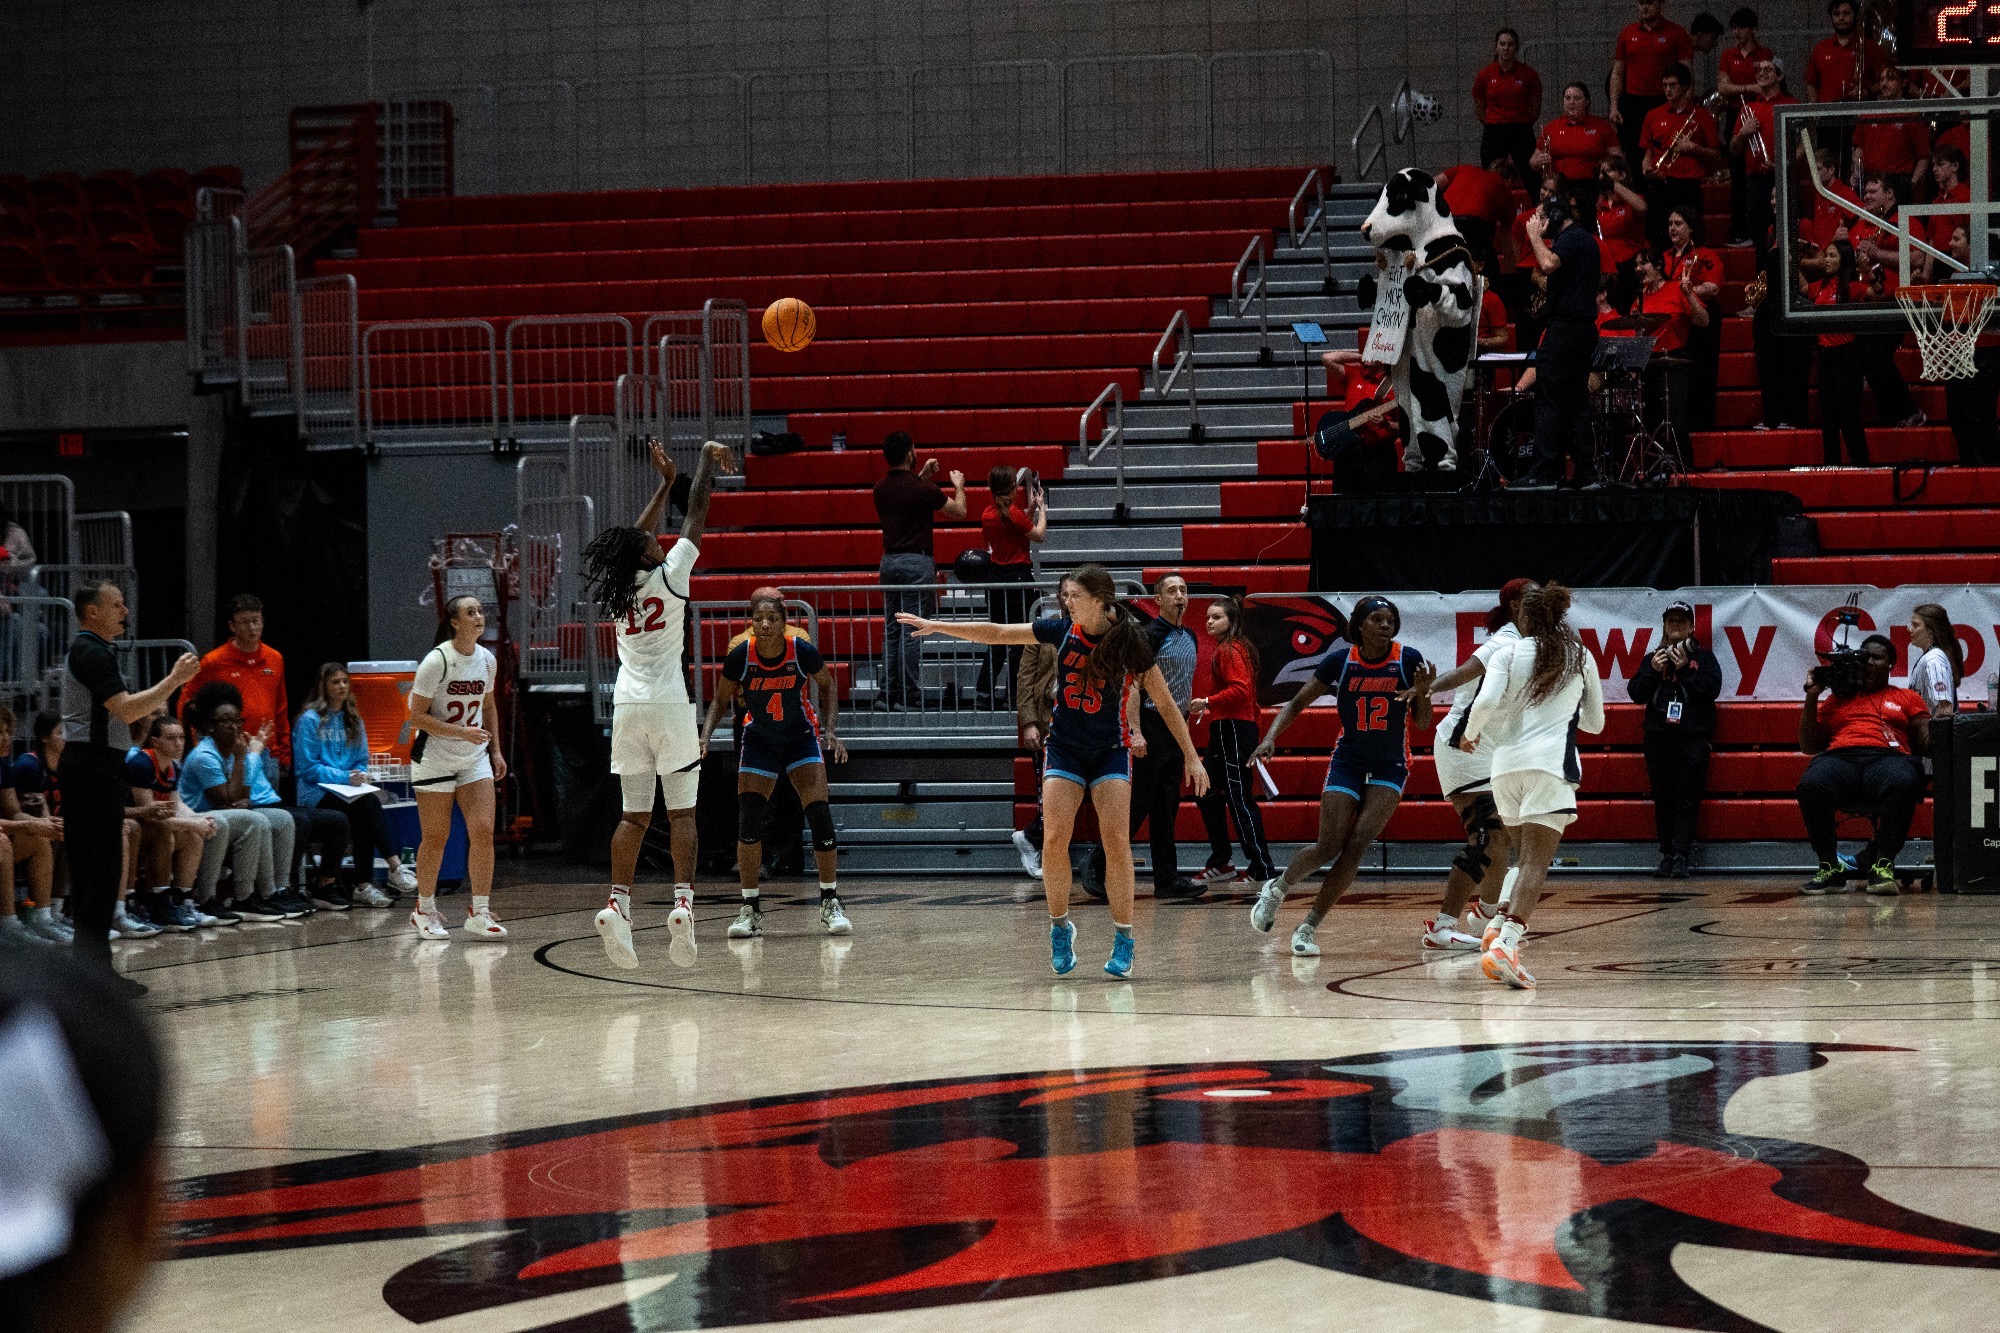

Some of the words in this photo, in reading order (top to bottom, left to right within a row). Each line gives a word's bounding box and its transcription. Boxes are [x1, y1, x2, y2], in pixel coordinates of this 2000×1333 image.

[624, 597, 666, 635] 12
[447, 680, 485, 695] SEMO
[1063, 672, 1105, 714] 25
[446, 701, 481, 727] 22
[765, 692, 784, 721] 4
[1355, 696, 1390, 731] 12
[1970, 756, 2000, 828] F
